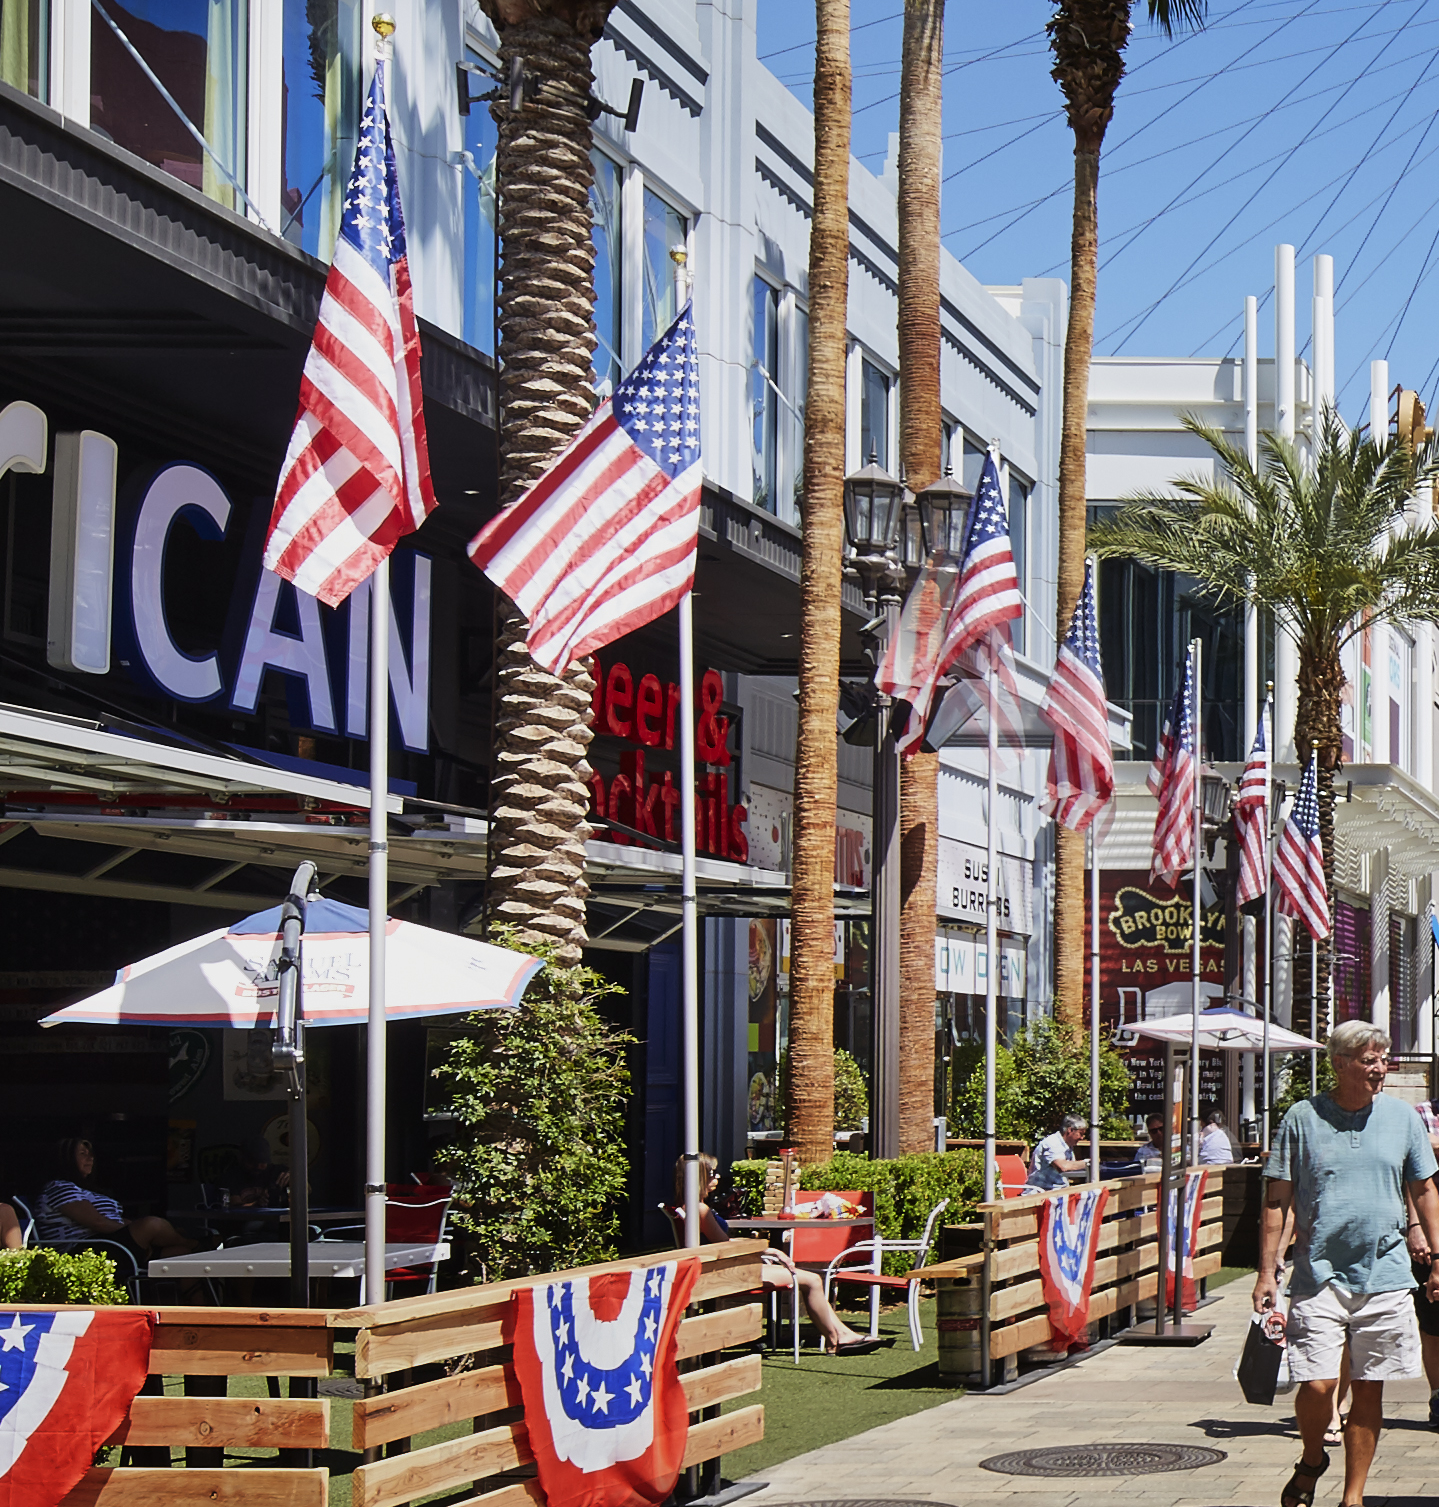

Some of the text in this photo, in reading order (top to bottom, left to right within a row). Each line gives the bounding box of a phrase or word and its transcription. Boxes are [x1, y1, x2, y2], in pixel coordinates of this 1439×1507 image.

[697, 669, 731, 767] &
[964, 859, 1000, 886] SUSI
[952, 887, 1010, 917] BURRIOS
[1119, 906, 1226, 935] BROOKYN
[1156, 925, 1204, 940] BOW
[940, 946, 1021, 982] OW OEN
[1122, 959, 1158, 973] LAS
